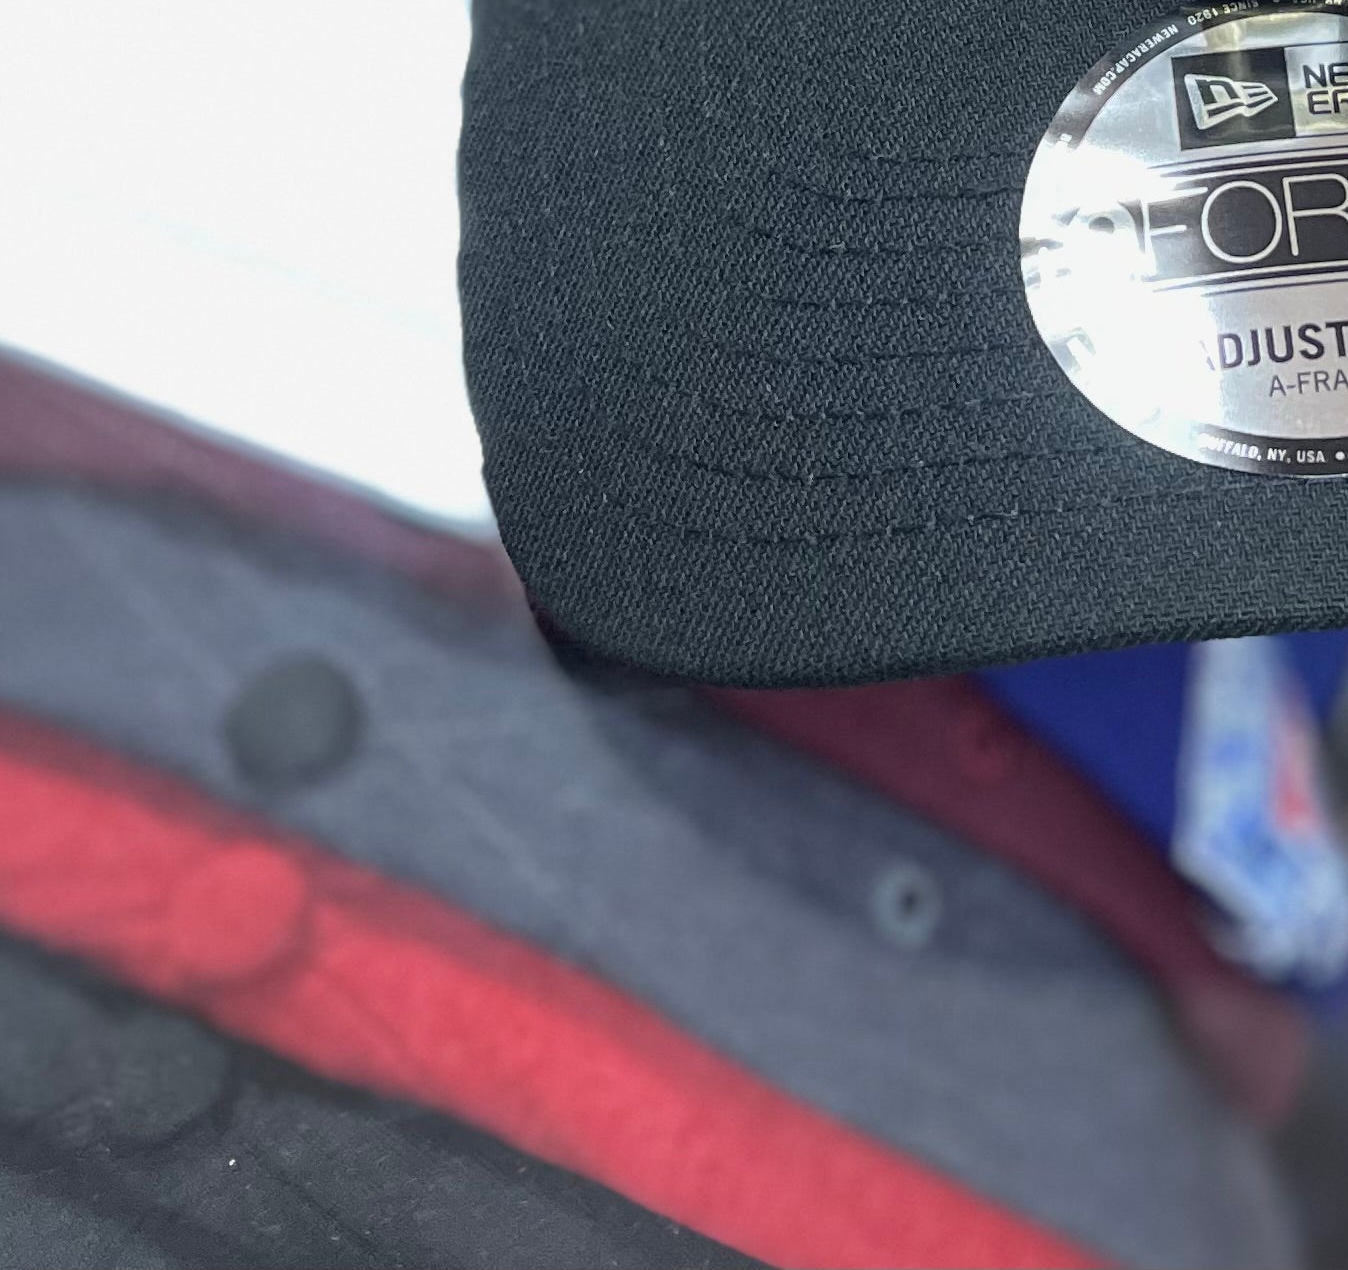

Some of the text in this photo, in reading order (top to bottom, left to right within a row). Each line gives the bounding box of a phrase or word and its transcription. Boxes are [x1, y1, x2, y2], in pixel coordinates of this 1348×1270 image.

[1187, 6, 1219, 26] 1920
[1199, 432, 1262, 461] FFALO,
[1296, 450, 1326, 464] USA
